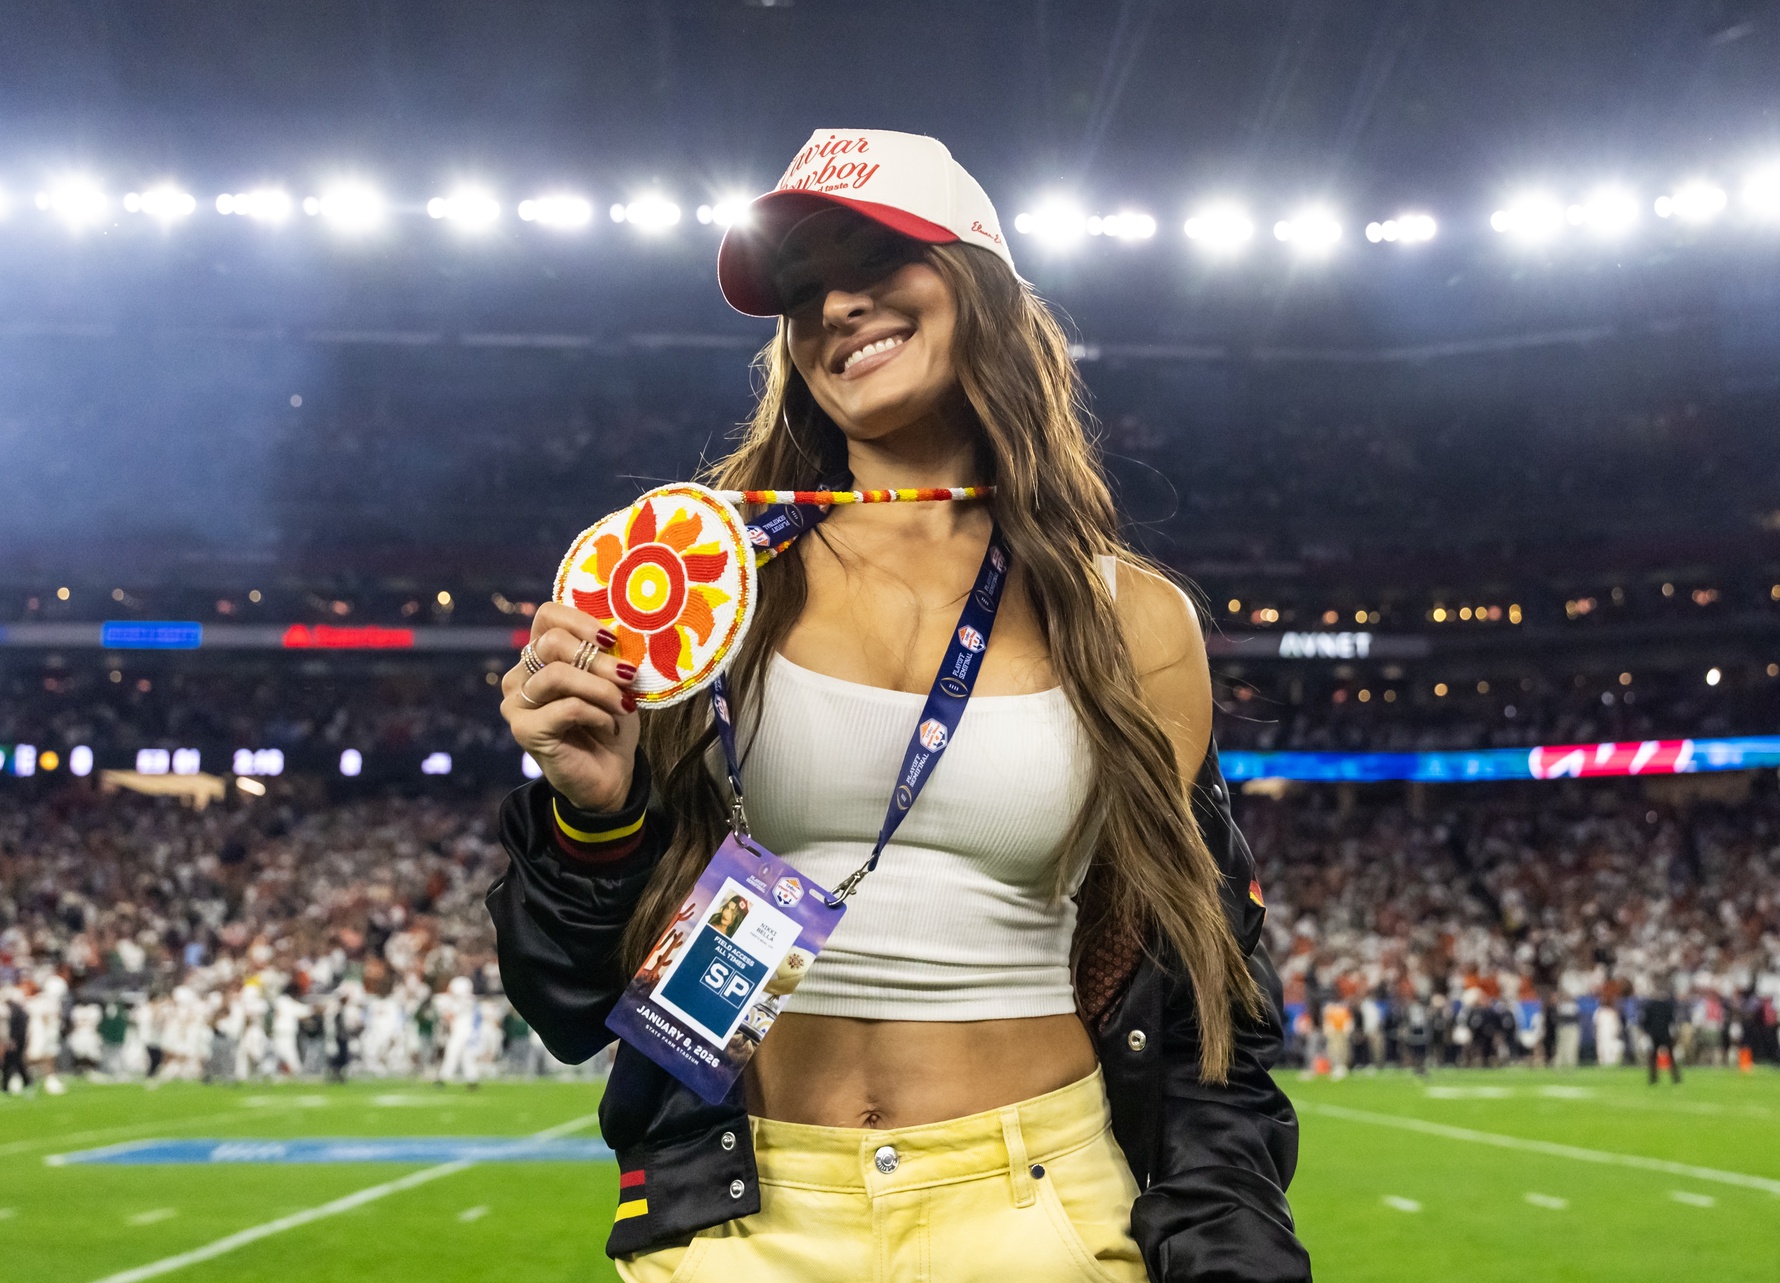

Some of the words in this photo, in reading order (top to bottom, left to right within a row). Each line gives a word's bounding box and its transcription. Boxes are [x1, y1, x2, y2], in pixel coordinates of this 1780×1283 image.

[789, 135, 870, 177] aviar
[781, 155, 880, 190] wboy
[952, 652, 966, 677] PLAYOFF
[958, 652, 974, 680] SEMIFINAL
[905, 753, 921, 784] PLAYOFF
[909, 753, 930, 788] SEMIFINAL
[756, 927, 774, 942] BELLA
[760, 922, 777, 937] NIKKI
[714, 935, 733, 951] FIELD
[731, 948, 755, 967] ACCESS
[714, 945, 727, 957] ALL
[727, 952, 746, 970] TIMES
[636, 1005, 685, 1041] JANUARY
[683, 1037, 692, 1051] 8,
[693, 1045, 721, 1068] 2026
[645, 1024, 661, 1038] STATE
[661, 1036, 676, 1049] FARM
[676, 1046, 699, 1066] STADIUM
